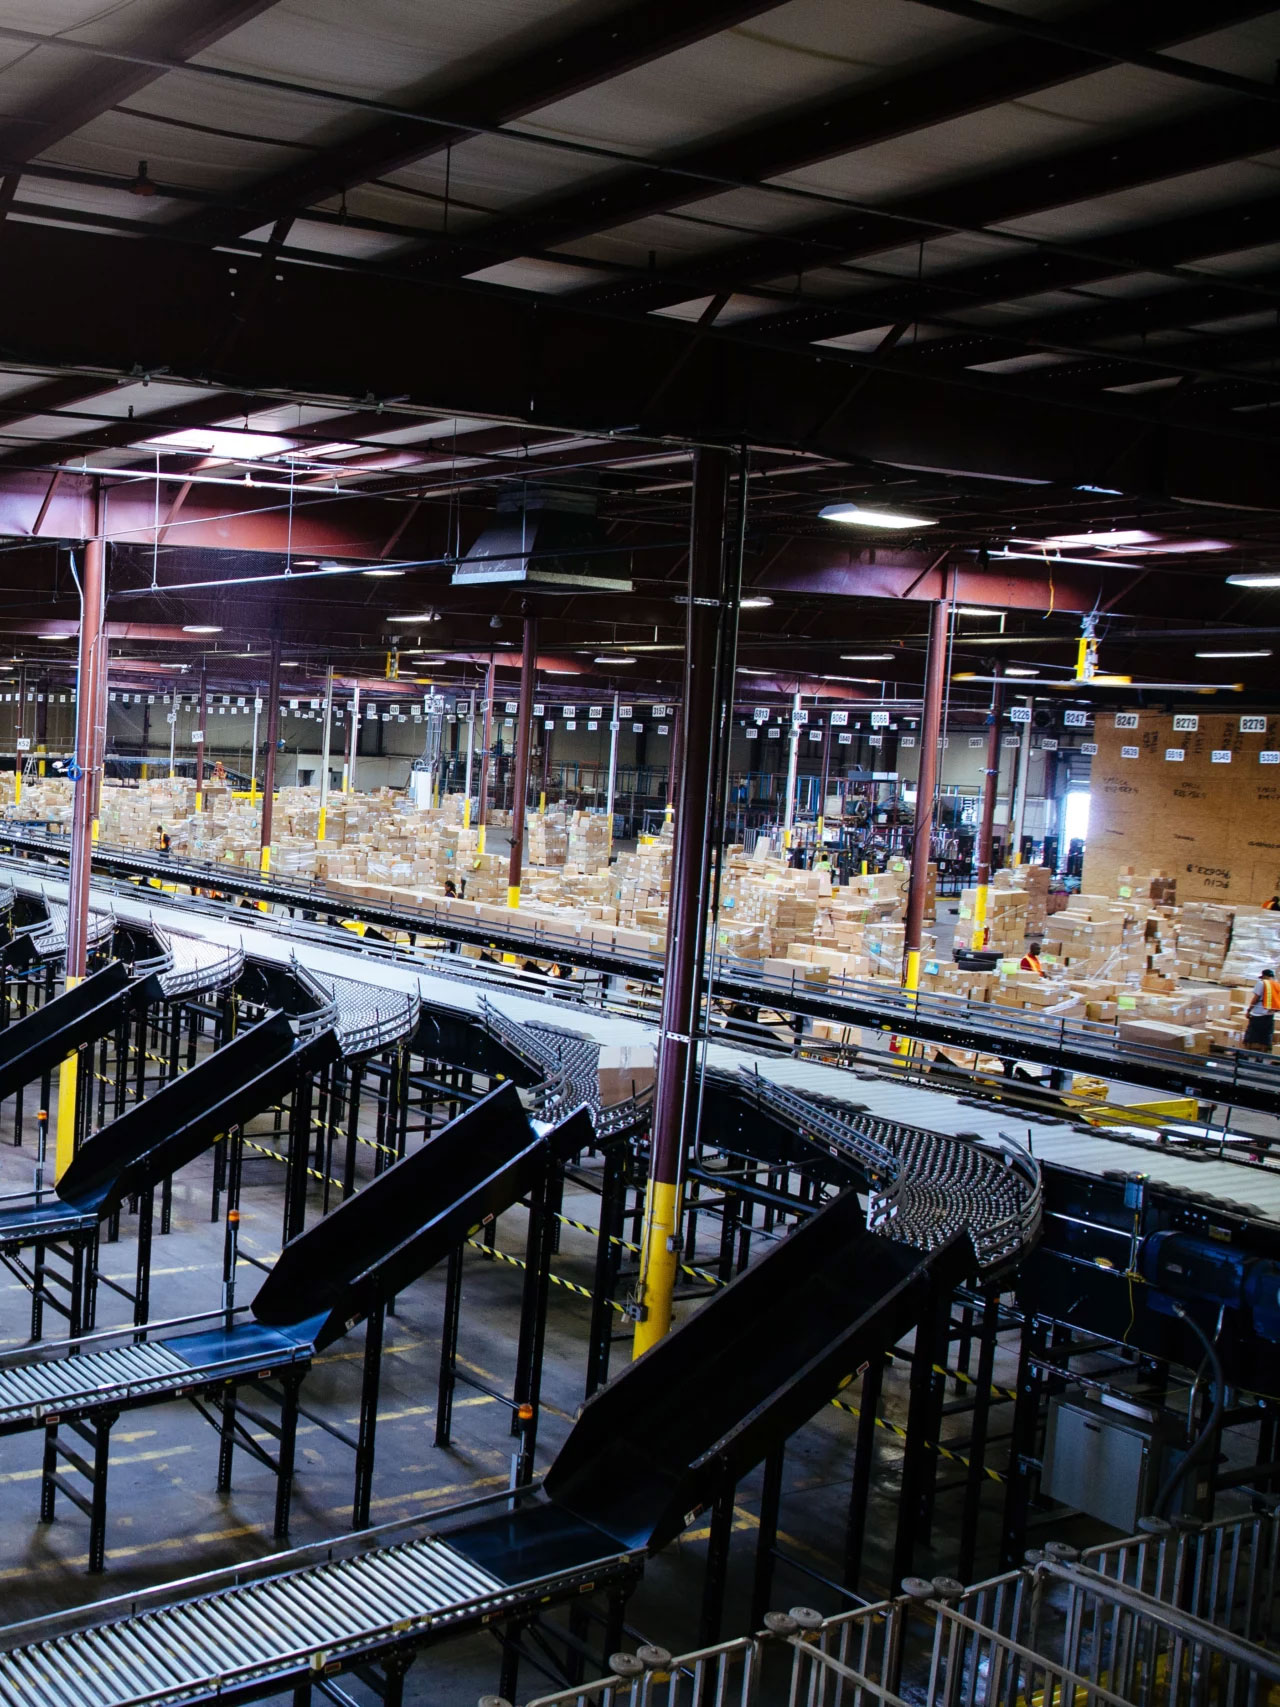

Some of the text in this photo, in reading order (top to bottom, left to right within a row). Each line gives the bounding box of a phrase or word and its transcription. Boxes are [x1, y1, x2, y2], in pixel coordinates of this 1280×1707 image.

[832, 713, 846, 723] 8064
[1012, 709, 1030, 720] 8226
[1066, 713, 1084, 724] 8247
[1116, 715, 1136, 726] 8247
[1175, 717, 1196, 729] 8279
[1242, 718, 1265, 730] 8279
